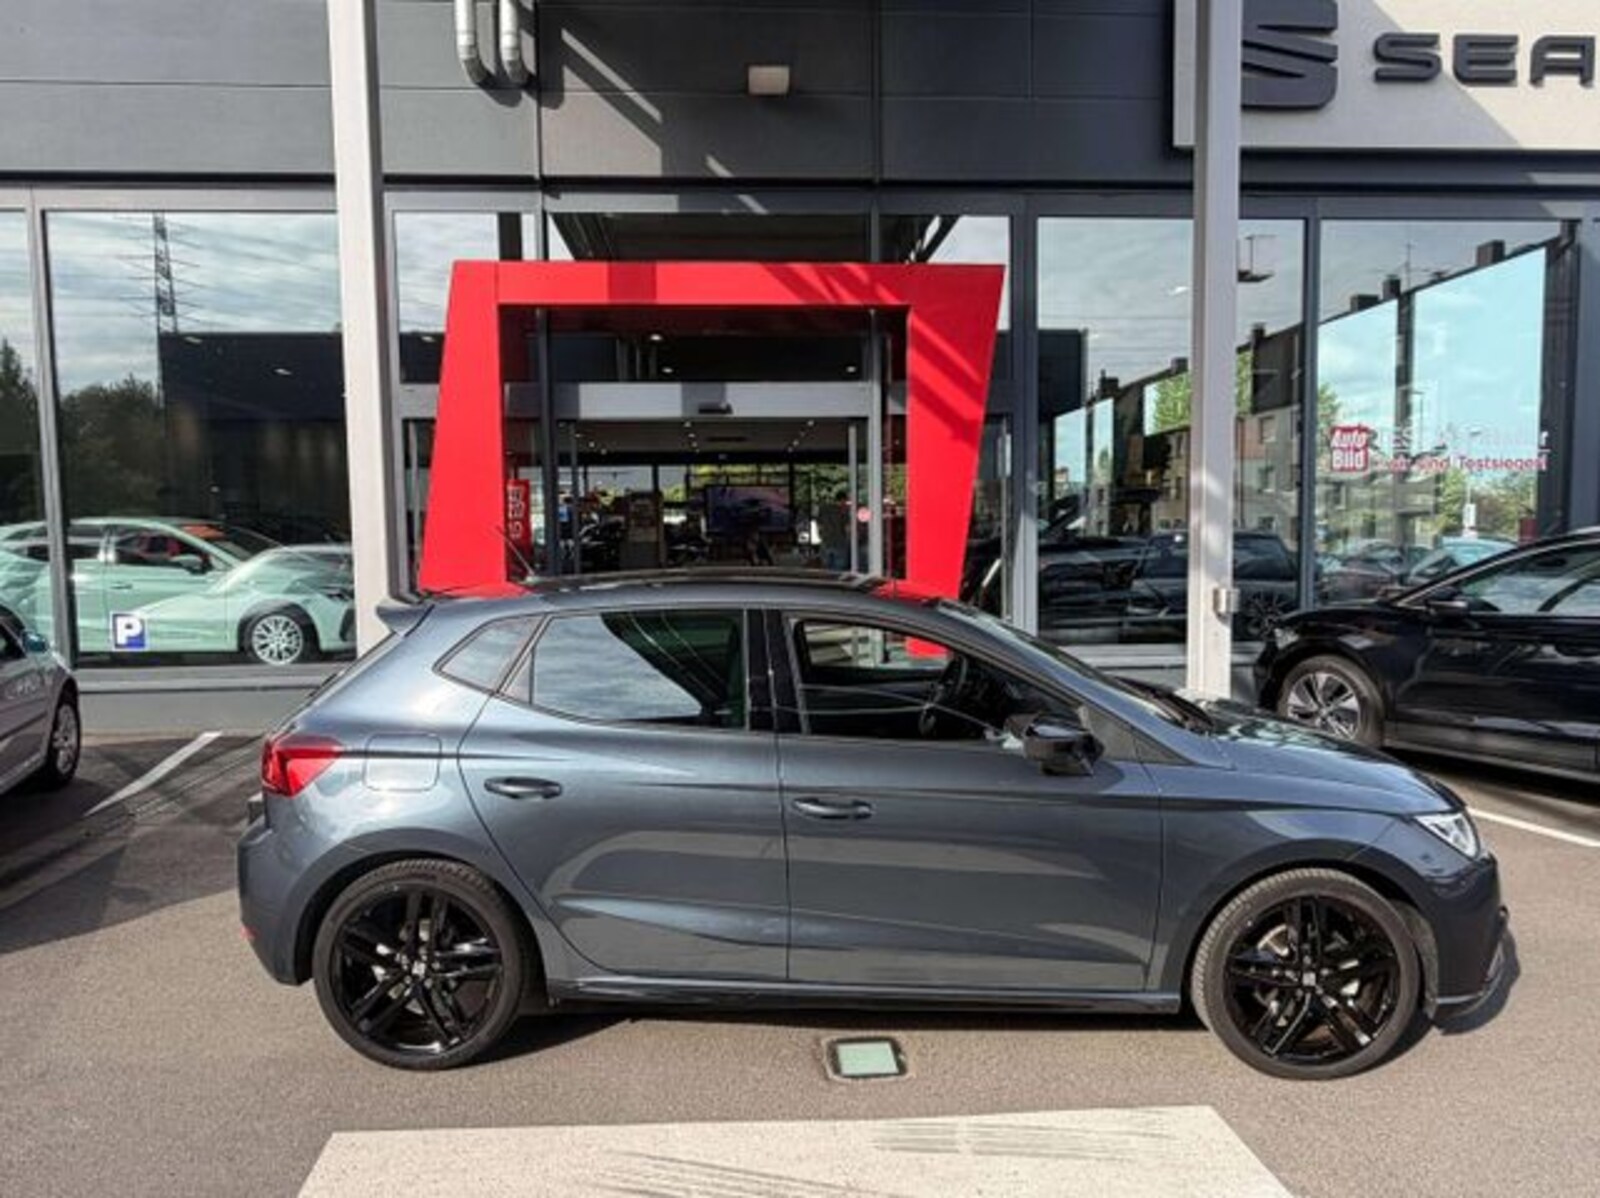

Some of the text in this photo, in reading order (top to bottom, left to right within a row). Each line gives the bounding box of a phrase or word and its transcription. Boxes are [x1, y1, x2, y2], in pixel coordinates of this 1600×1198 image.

[1330, 429, 1367, 448] Auto
[1332, 449, 1365, 469] Bild
[117, 616, 142, 645] P
